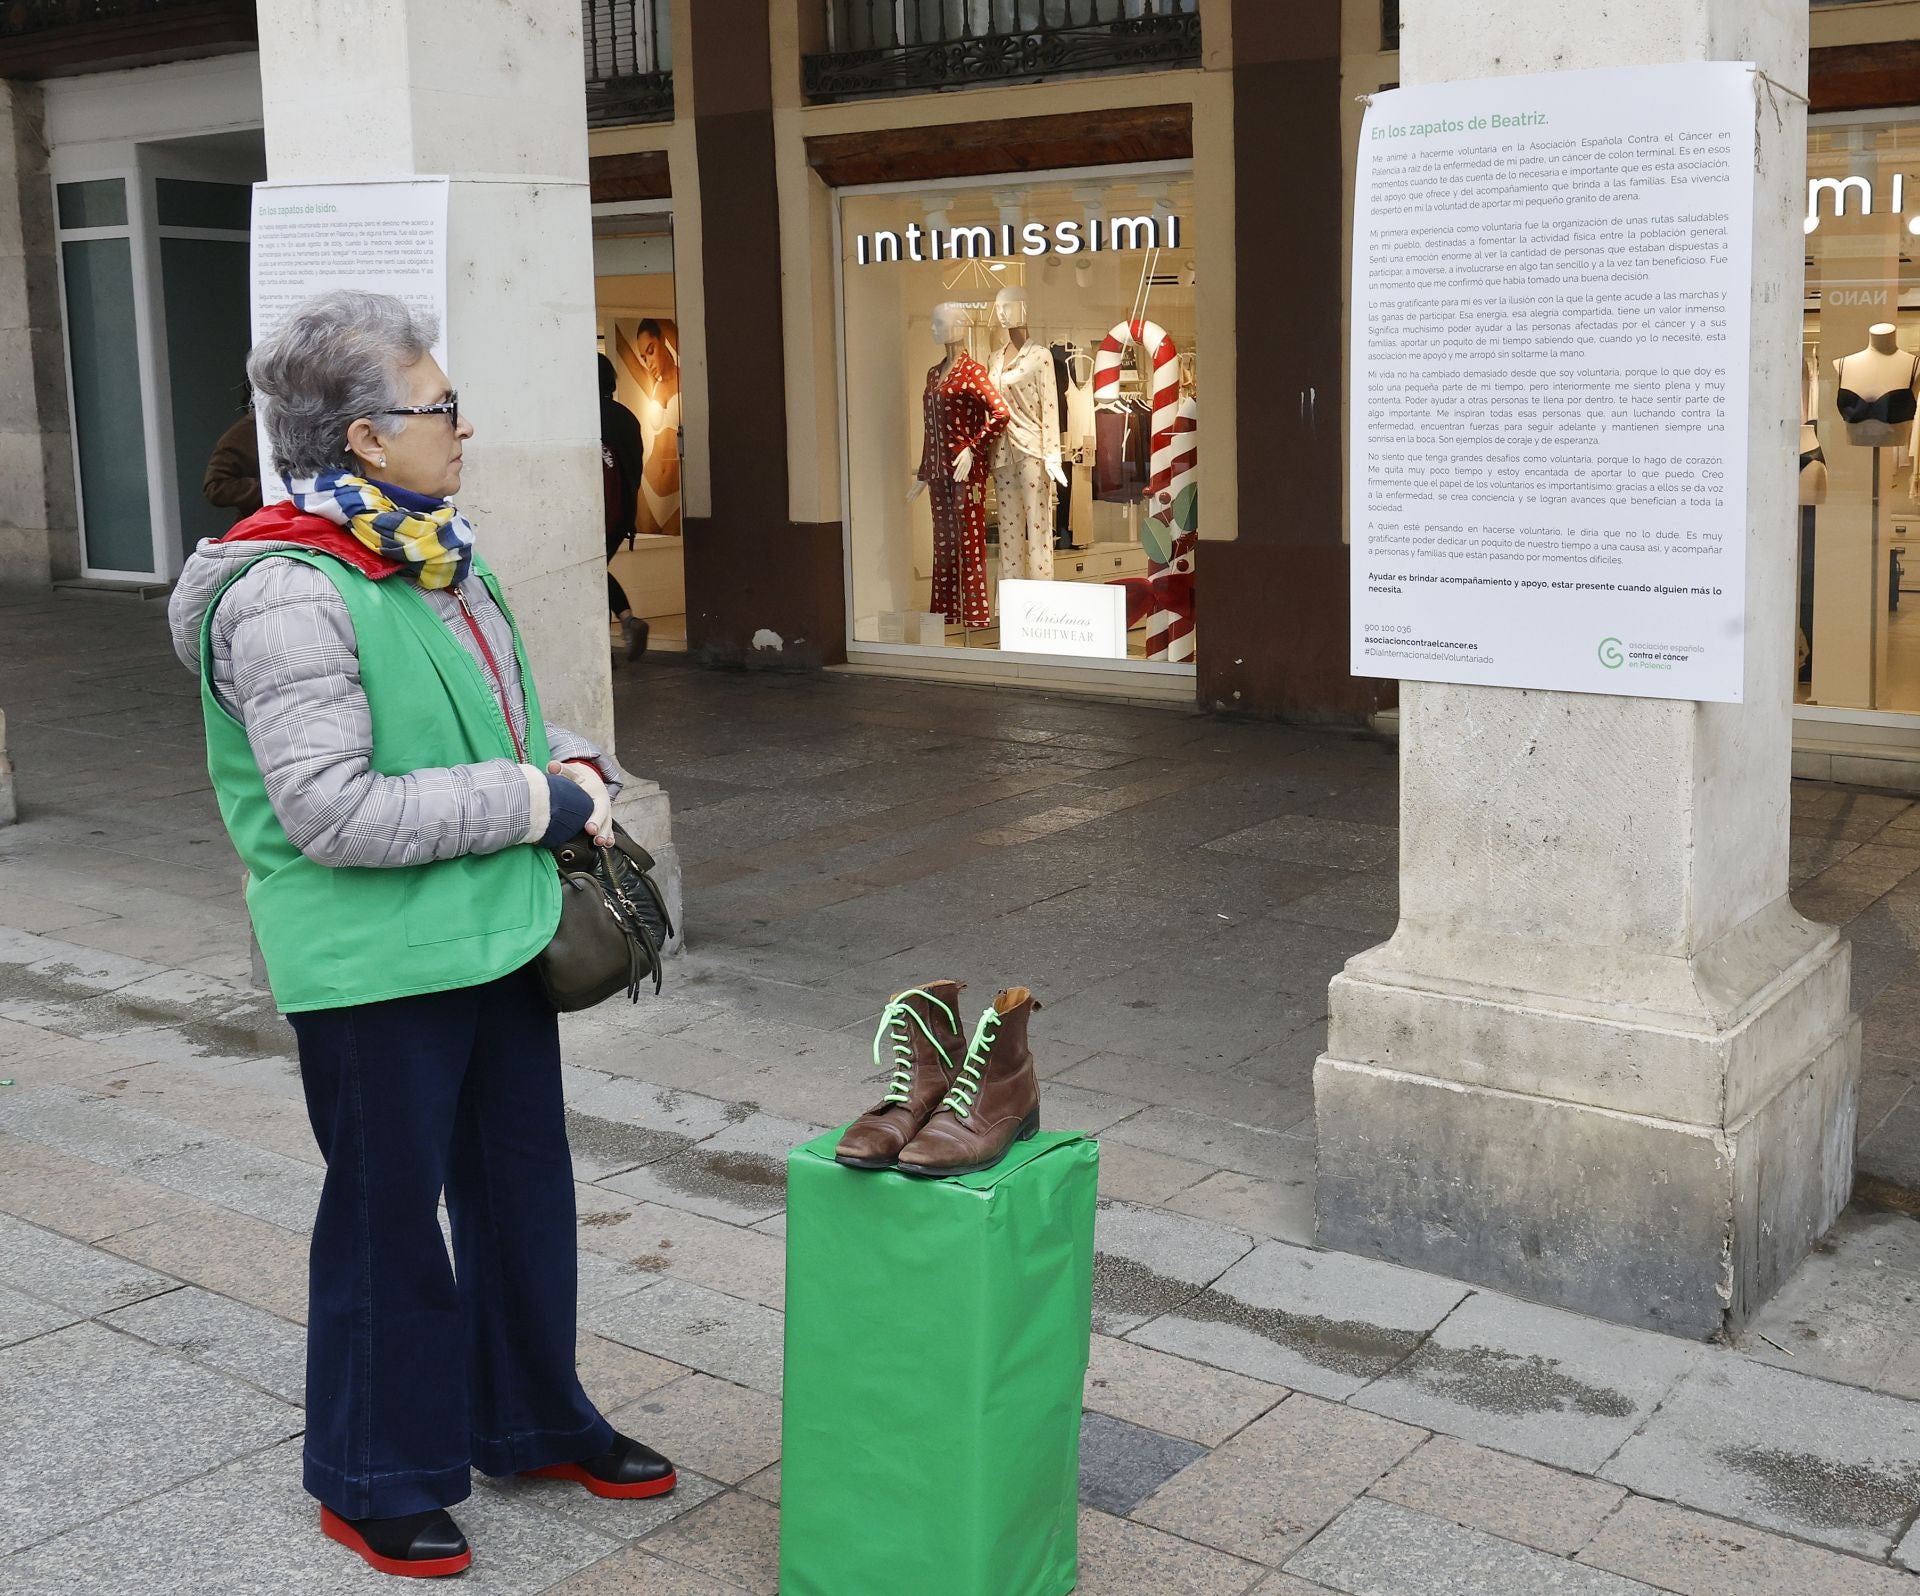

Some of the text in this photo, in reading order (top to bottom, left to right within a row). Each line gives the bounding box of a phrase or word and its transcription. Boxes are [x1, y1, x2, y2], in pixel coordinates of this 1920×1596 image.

[1371, 111, 1548, 140] En los zapatos de Beatriz.
[1419, 149, 1455, 158] hacerme
[1456, 146, 1497, 155] voluntaria
[1517, 143, 1526, 151] la
[1528, 139, 1577, 150] Asociación
[1580, 136, 1624, 149] Española
[1625, 134, 1659, 144] Contra
[1664, 132, 1674, 142] el
[1717, 131, 1730, 139] en
[1370, 193, 1382, 202] del
[1383, 192, 1408, 202] apoyo
[1406, 191, 1425, 201] que
[1424, 188, 1451, 198] ofrece
[1452, 190, 1458, 198] y
[1460, 187, 1473, 195] del
[1475, 183, 1550, 195] acompañamiento
[1550, 182, 1569, 192] que
[1572, 178, 1601, 189] brinda
[1612, 178, 1628, 187] las
[1670, 175, 1688, 184] Esa
[1689, 173, 1730, 182] vivencia
[258, 206, 267, 216] En
[268, 206, 277, 215] los
[278, 204, 304, 216] zapatos
[304, 203, 315, 214] de
[857, 215, 1179, 265] intimissimi
[1440, 252, 1472, 260] enorme
[1473, 250, 1483, 259] al
[1499, 249, 1508, 258] la
[1509, 247, 1548, 257] cantidad
[1547, 247, 1563, 255] de
[1562, 247, 1606, 256] personas
[1606, 246, 1626, 255] que
[1626, 241, 1667, 252] estaban
[1666, 240, 1719, 253] dispuestas
[1368, 325, 1399, 336] Significa
[1447, 321, 1472, 334] poder
[1473, 321, 1503, 333] ayudar
[1515, 321, 1529, 331] las
[1531, 323, 1571, 332] personas
[1574, 319, 1619, 329] afectadas
[1621, 321, 1639, 331] por
[1640, 319, 1651, 328] el
[1689, 320, 1697, 329] y
[1699, 319, 1706, 327] a
[1709, 319, 1727, 327] sus
[1379, 370, 1395, 378] vida
[1409, 369, 1419, 378] ha
[1421, 368, 1461, 378] cambiado
[1462, 369, 1508, 377] demasiado
[1510, 367, 1538, 377] desde
[1537, 368, 1558, 379] que
[1558, 368, 1575, 379] soy
[1624, 369, 1658, 377] porque
[1659, 367, 1671, 376] lo
[1671, 368, 1691, 377] que
[1693, 367, 1712, 377] doy
[1367, 409, 1384, 419] algo
[1436, 408, 1449, 417] Me
[1453, 409, 1485, 418] inspiran
[1488, 407, 1513, 417] todas
[1541, 410, 1582, 418] personas
[1633, 406, 1677, 417] luchando
[1679, 409, 1711, 417] contra
[1714, 408, 1725, 417] la
[1469, 422, 1501, 430] fuerzas
[1503, 423, 1524, 432] para
[1527, 422, 1554, 432] seguir
[1558, 422, 1596, 431] adelante
[1600, 424, 1607, 432] y
[1611, 422, 1659, 431] mantienen
[1664, 421, 1701, 431] siempre
[1367, 465, 1380, 473] Me
[1384, 465, 1405, 475] quita
[1407, 467, 1426, 476] muy
[1429, 467, 1450, 476] poco
[1454, 464, 1483, 477] tiempo
[1487, 468, 1493, 477] y
[1496, 466, 1520, 478] estoy
[1523, 466, 1569, 476] encantada
[1573, 467, 1586, 476] de
[1590, 467, 1623, 479] aportar
[1625, 468, 1638, 477] lo
[1639, 470, 1661, 479] que
[1701, 469, 1724, 478] Creo
[1368, 572, 1396, 581] Ayudar
[1408, 573, 1438, 582] brindar
[1439, 576, 1512, 585] acompañamiento
[1513, 580, 1519, 588] y
[1520, 580, 1549, 588] apoyo,
[1653, 585, 1688, 594] alguien
[1690, 586, 1710, 594] más
[1712, 586, 1722, 595] lo
[1024, 600, 1091, 626] Christmas
[1022, 626, 1094, 642] NIGHTWEAR
[1364, 624, 1379, 632] 900
[1396, 625, 1412, 634] 036
[1364, 636, 1478, 650] asociacioncontraelcancer.es
[1629, 642, 1705, 653] asociación española
[1629, 651, 1689, 662] contra el cáncer
[1640, 661, 1672, 670] Palencia
